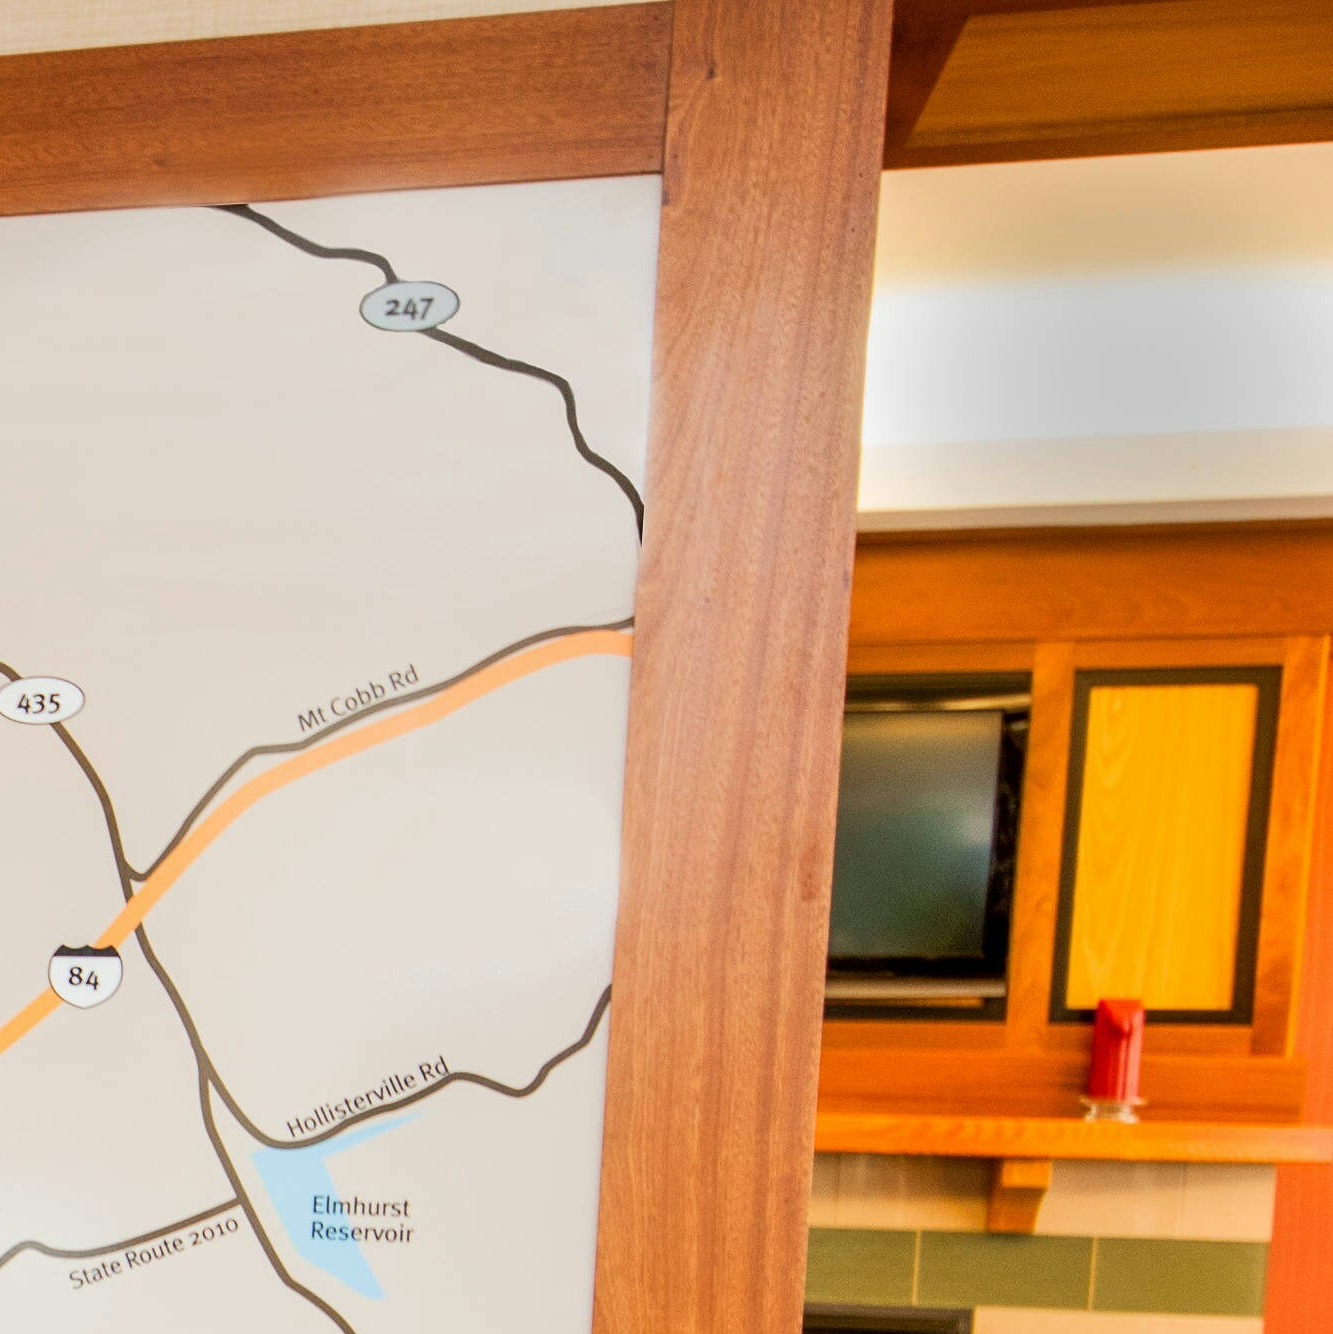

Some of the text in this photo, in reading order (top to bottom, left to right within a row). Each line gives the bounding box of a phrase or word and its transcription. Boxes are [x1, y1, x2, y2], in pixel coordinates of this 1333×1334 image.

[384, 296, 435, 321] 247
[17, 692, 62, 715] 435
[297, 664, 419, 733] Mt Cobb Rd
[68, 966, 100, 991] 84
[286, 1056, 451, 1138] Hollisterville Rd
[311, 1196, 412, 1217] Elmhurst
[310, 1221, 415, 1244] Reservoir
[69, 1217, 240, 1291] State Route 2010
